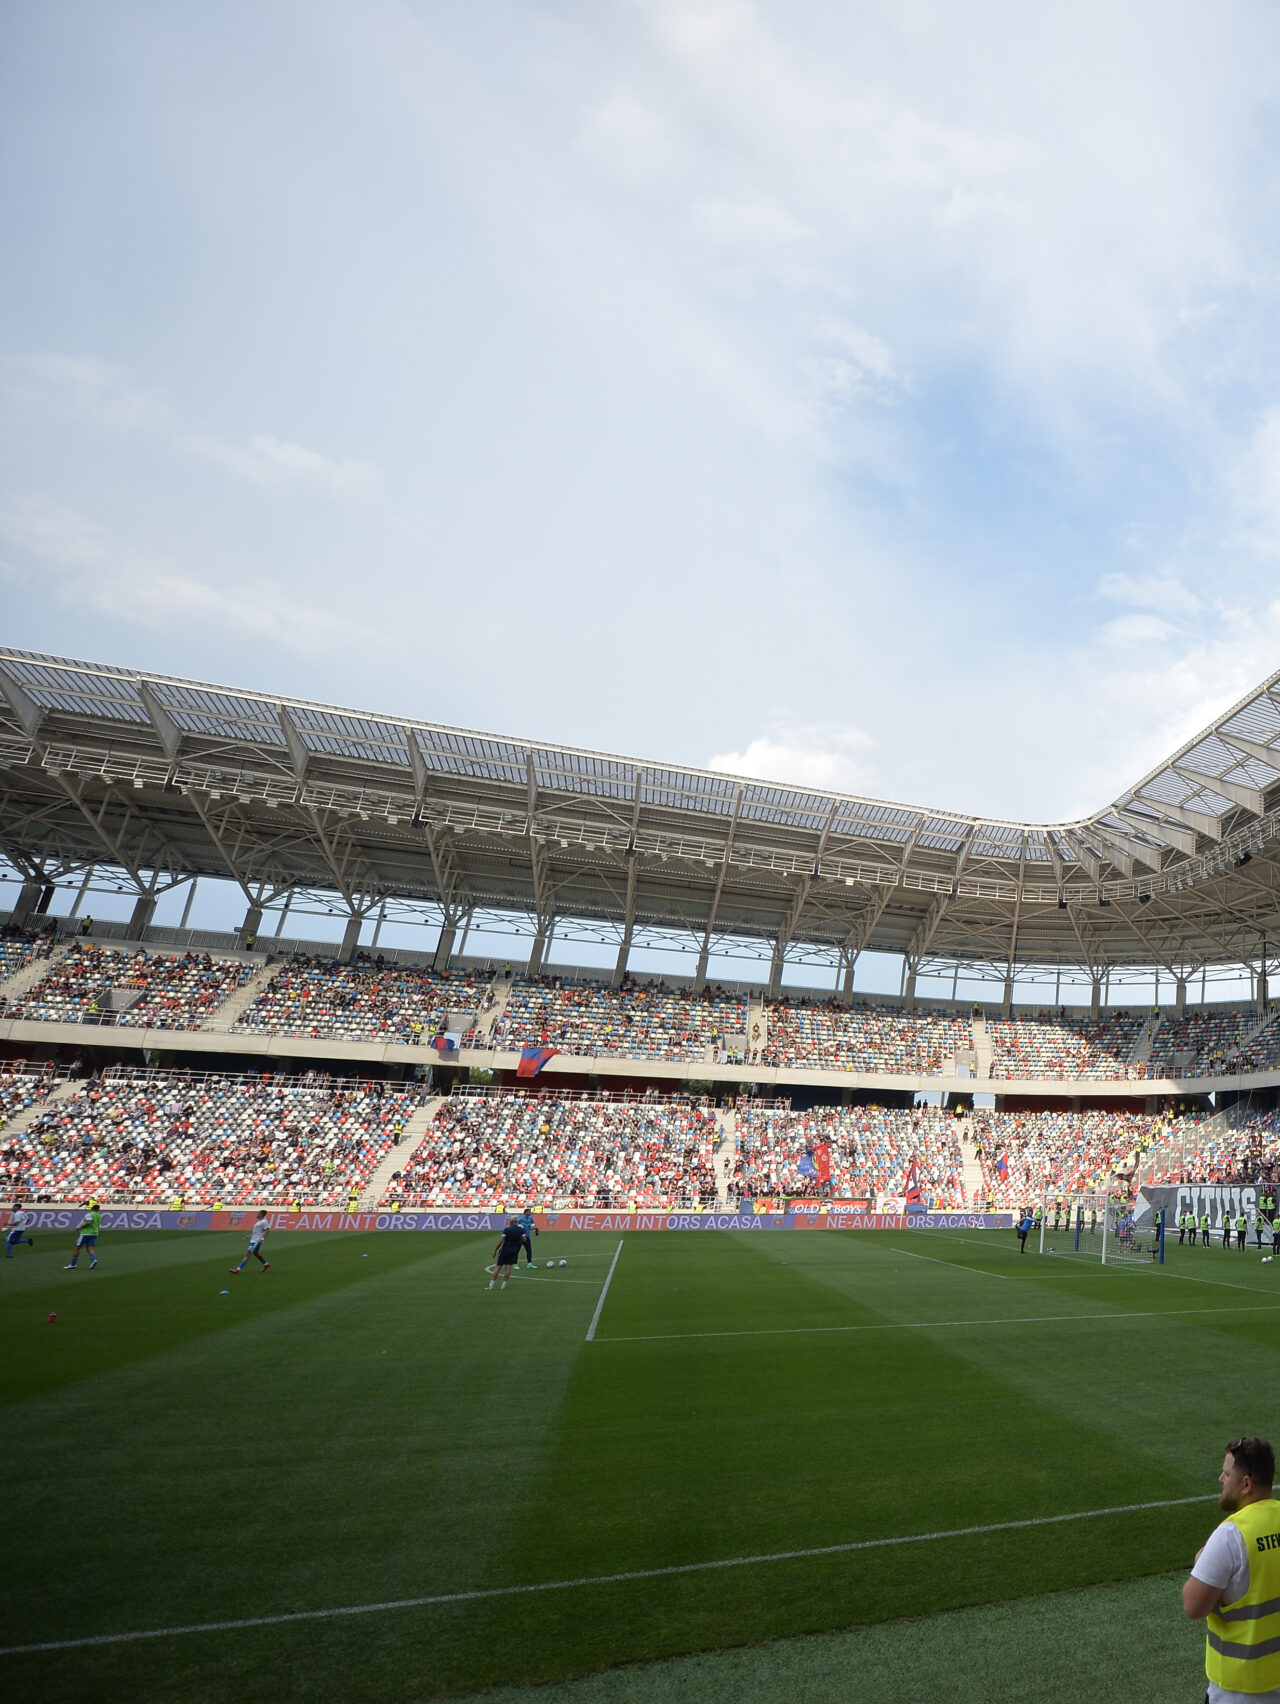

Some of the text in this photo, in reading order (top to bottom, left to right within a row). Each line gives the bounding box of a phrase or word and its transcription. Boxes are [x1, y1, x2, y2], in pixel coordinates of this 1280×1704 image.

[795, 1204, 861, 1214] OLD BOYS
[569, 1215, 631, 1229] NE-AM
[825, 1215, 876, 1229] NE-AM
